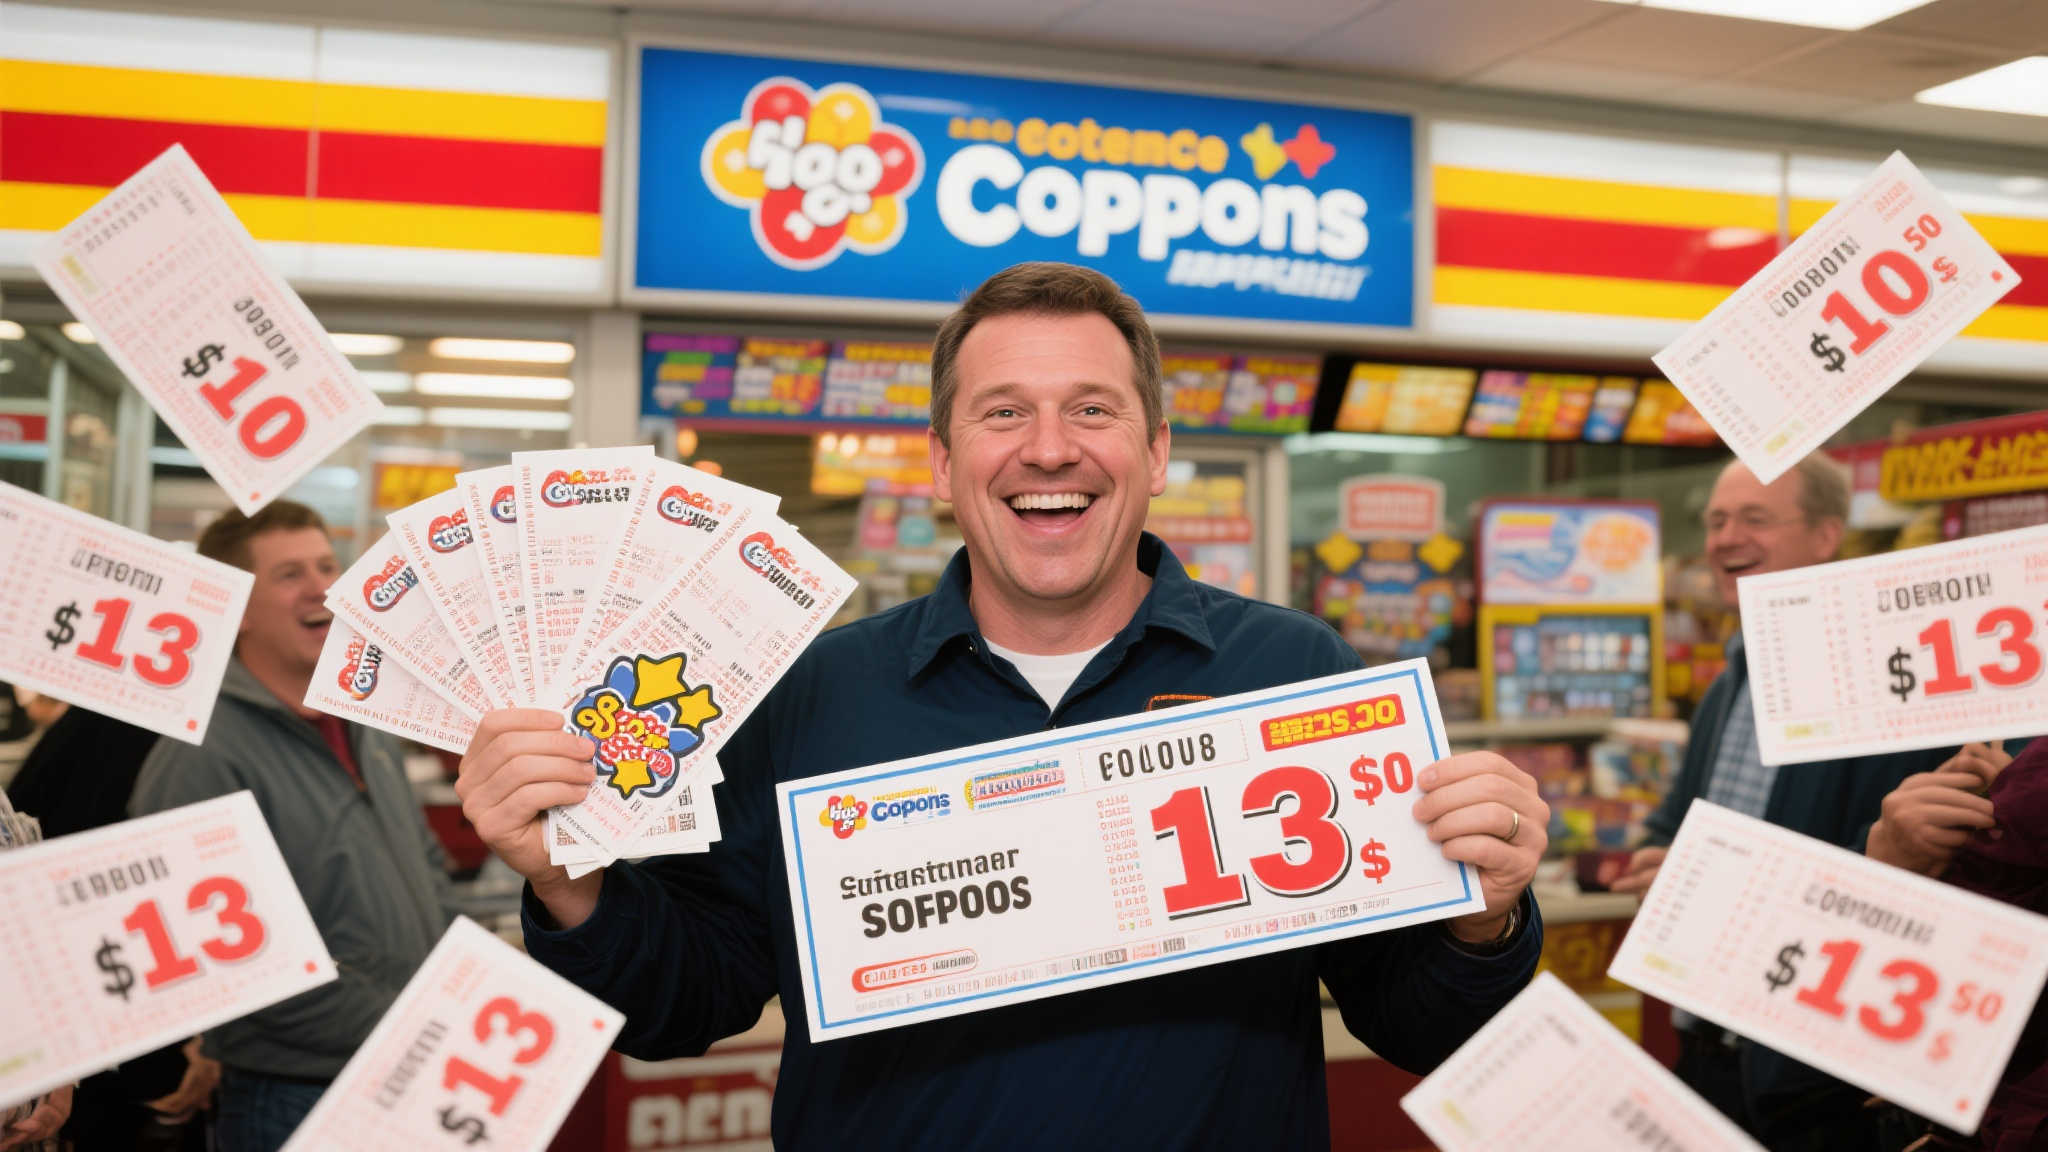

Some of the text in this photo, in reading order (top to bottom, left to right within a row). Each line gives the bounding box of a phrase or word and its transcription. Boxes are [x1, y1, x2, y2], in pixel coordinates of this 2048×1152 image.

[937, 144, 1370, 262] Coppons
[1903, 213, 1942, 252] 50
[1810, 249, 1931, 373] $10
[182, 343, 307, 460] $10
[45, 596, 200, 689] $13
[1888, 605, 2043, 703] $13
[1150, 765, 1353, 921] 13
[1360, 837, 1391, 884] $
[95, 875, 267, 1003] $13
[862, 875, 1032, 939] SOFPOOS
[1765, 939, 1940, 1043] $13
[437, 996, 556, 1145] $13
